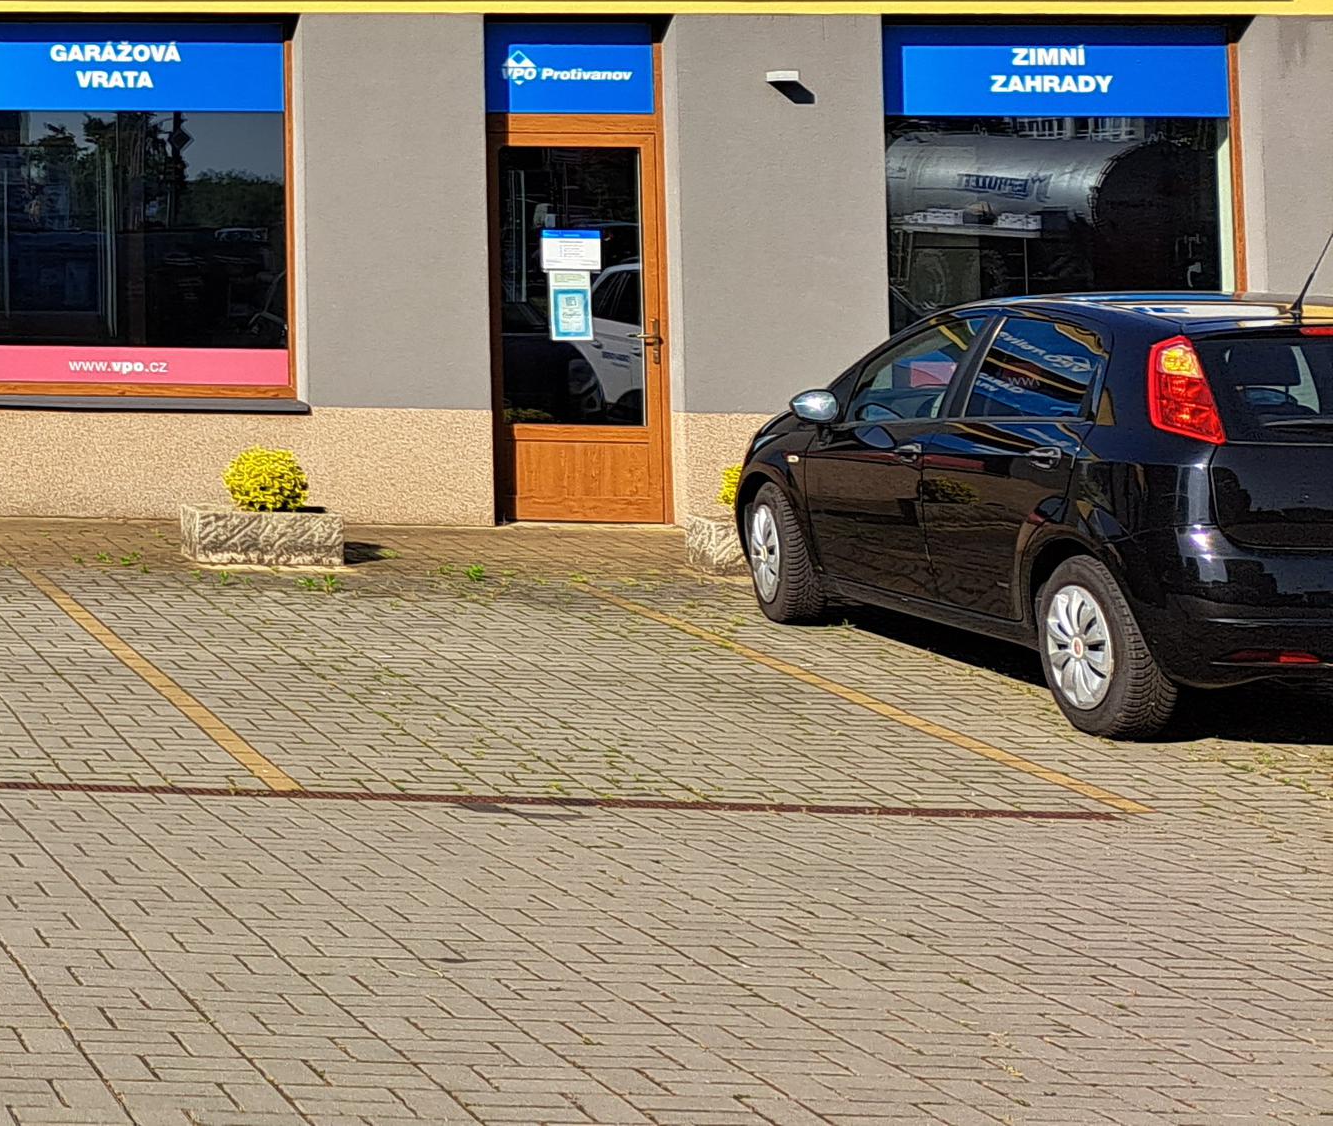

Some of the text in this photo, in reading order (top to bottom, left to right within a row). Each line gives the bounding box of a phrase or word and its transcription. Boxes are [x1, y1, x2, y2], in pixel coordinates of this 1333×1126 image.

[50, 41, 181, 62] GARÁŽOVÁ
[1012, 44, 1085, 66] ZIMNÍ
[76, 71, 154, 88] VRATA
[541, 67, 632, 81] Protivanov
[990, 75, 1113, 93] ZAHRADY
[69, 360, 168, 374] www.vpo.cz
